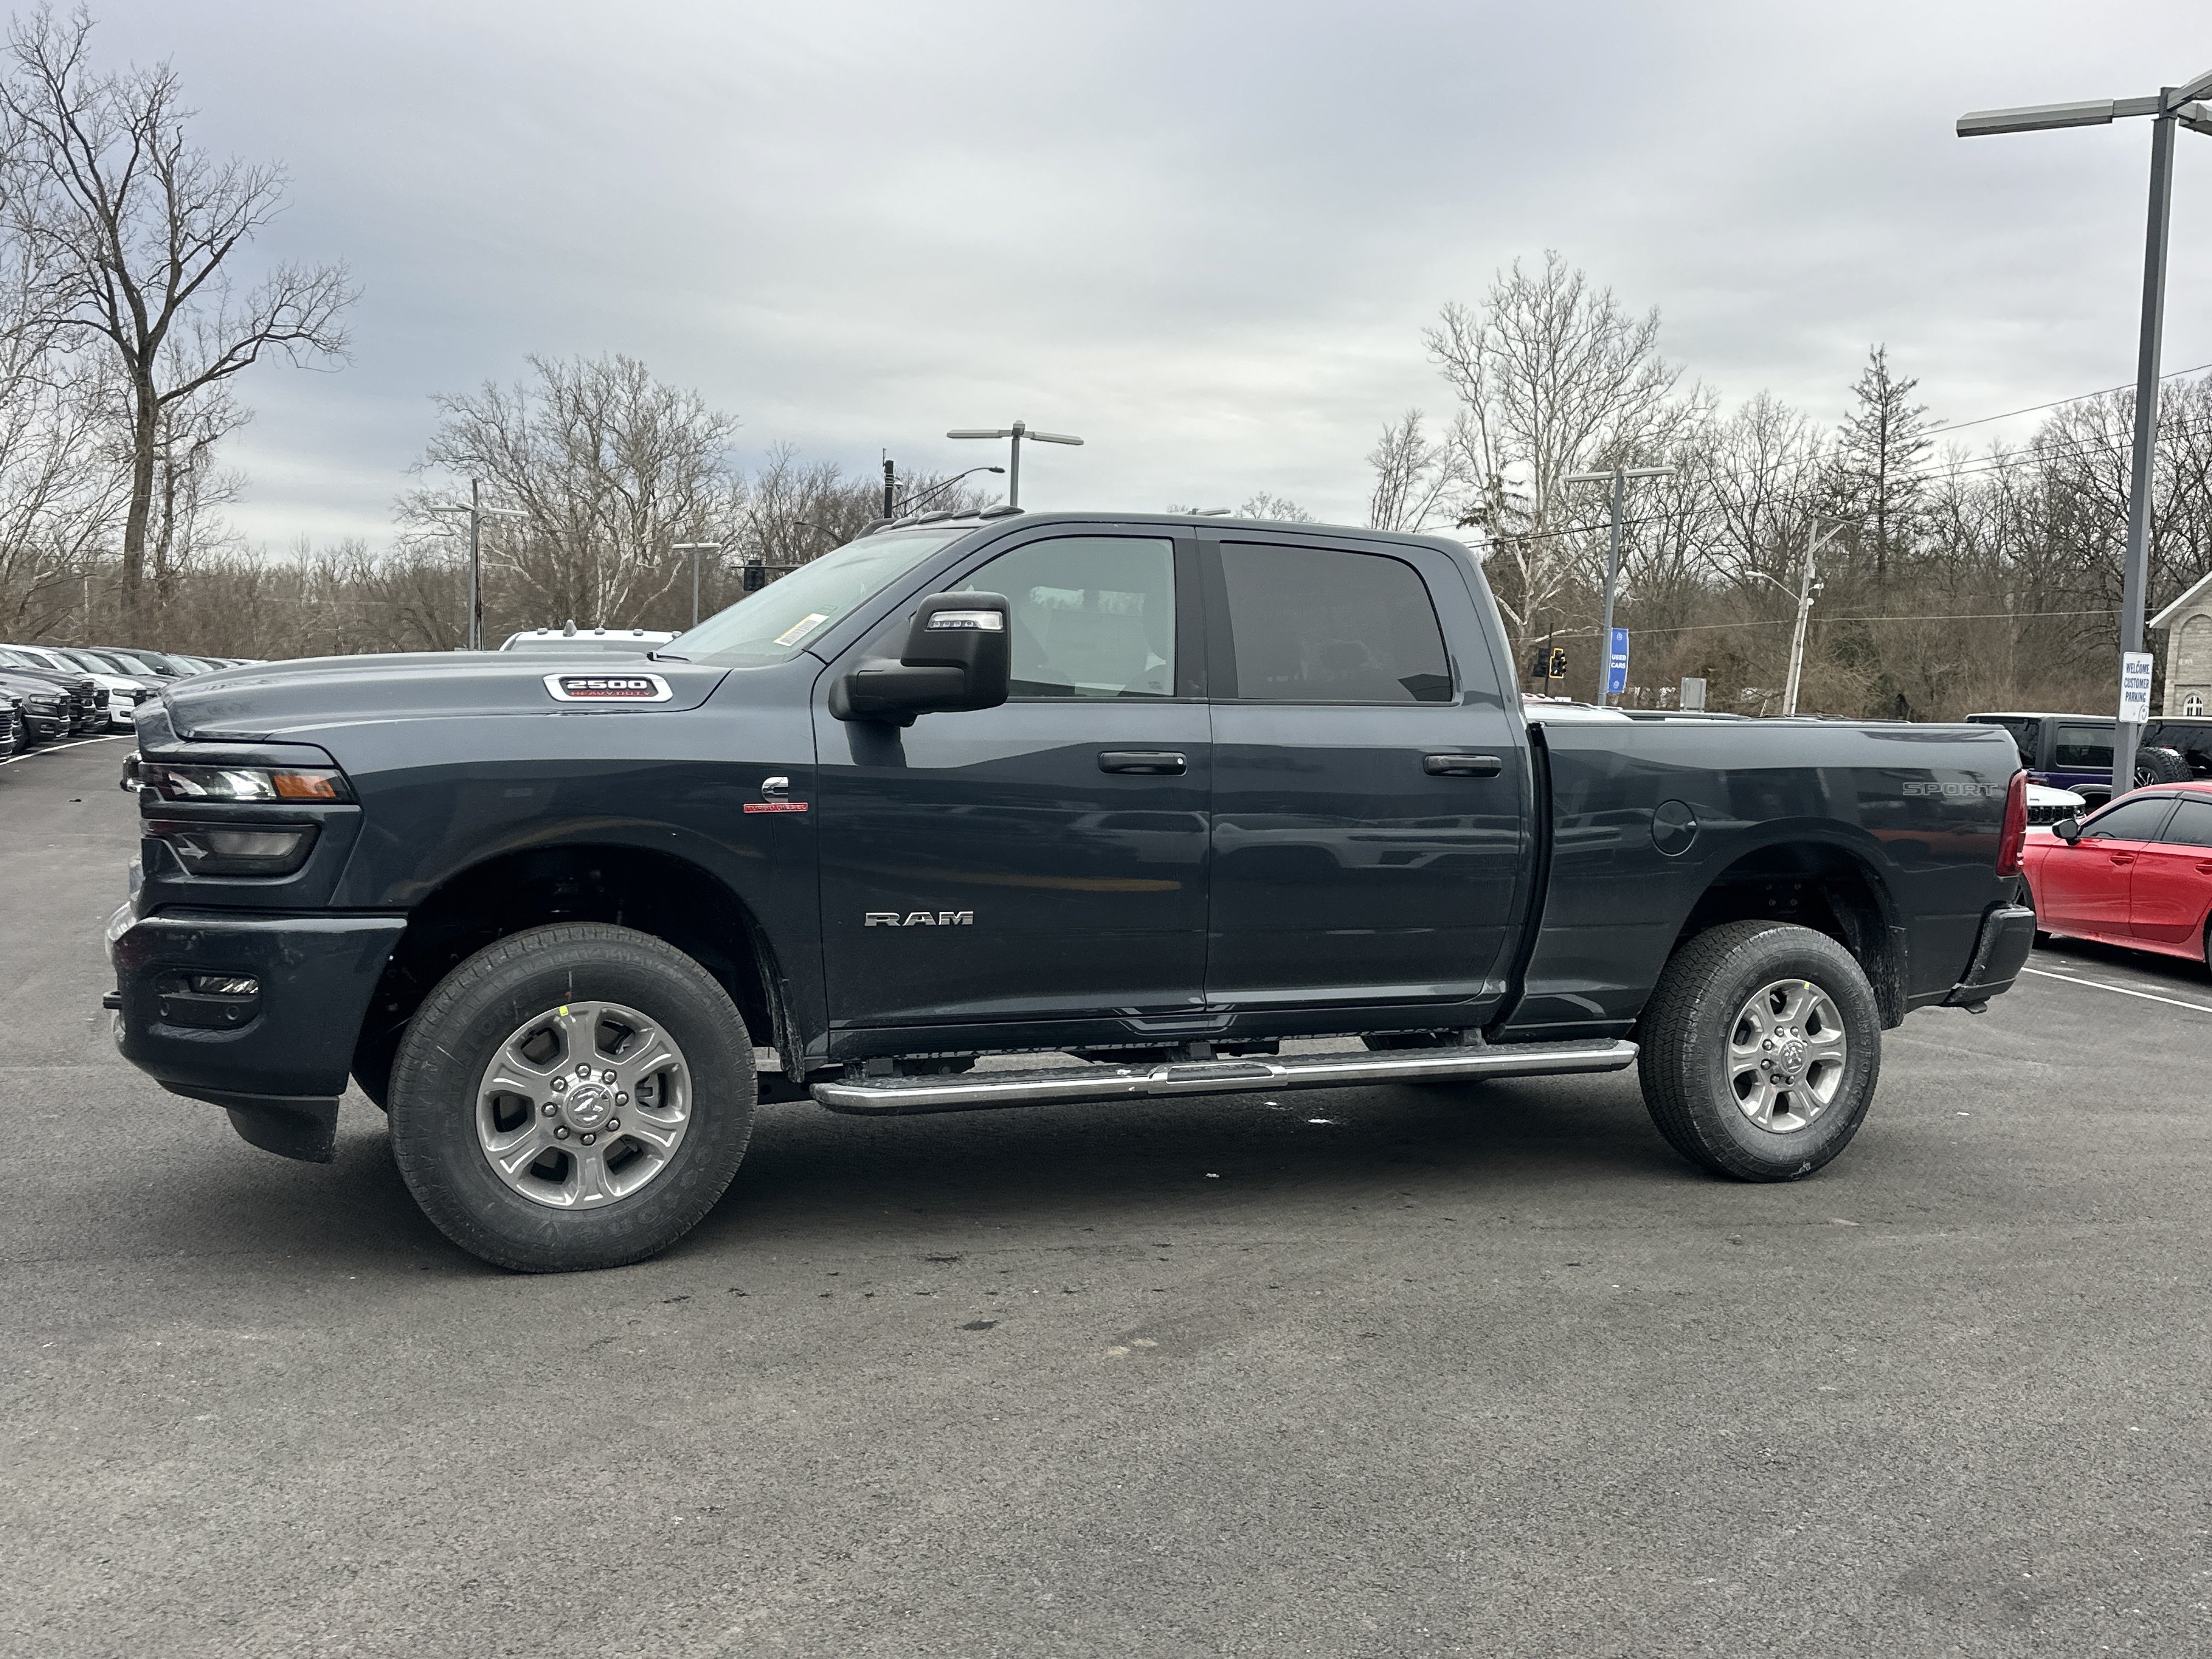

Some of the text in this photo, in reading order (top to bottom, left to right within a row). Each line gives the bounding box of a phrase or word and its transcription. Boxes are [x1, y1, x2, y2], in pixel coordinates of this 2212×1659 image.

[2126, 663, 2150, 674] WELCOME
[566, 680, 647, 689] 2500
[2124, 677, 2150, 689] CUSTOMER
[2125, 691, 2146, 702] PARKING
[1902, 782, 1999, 796] SPORT
[864, 911, 974, 927] RAM
